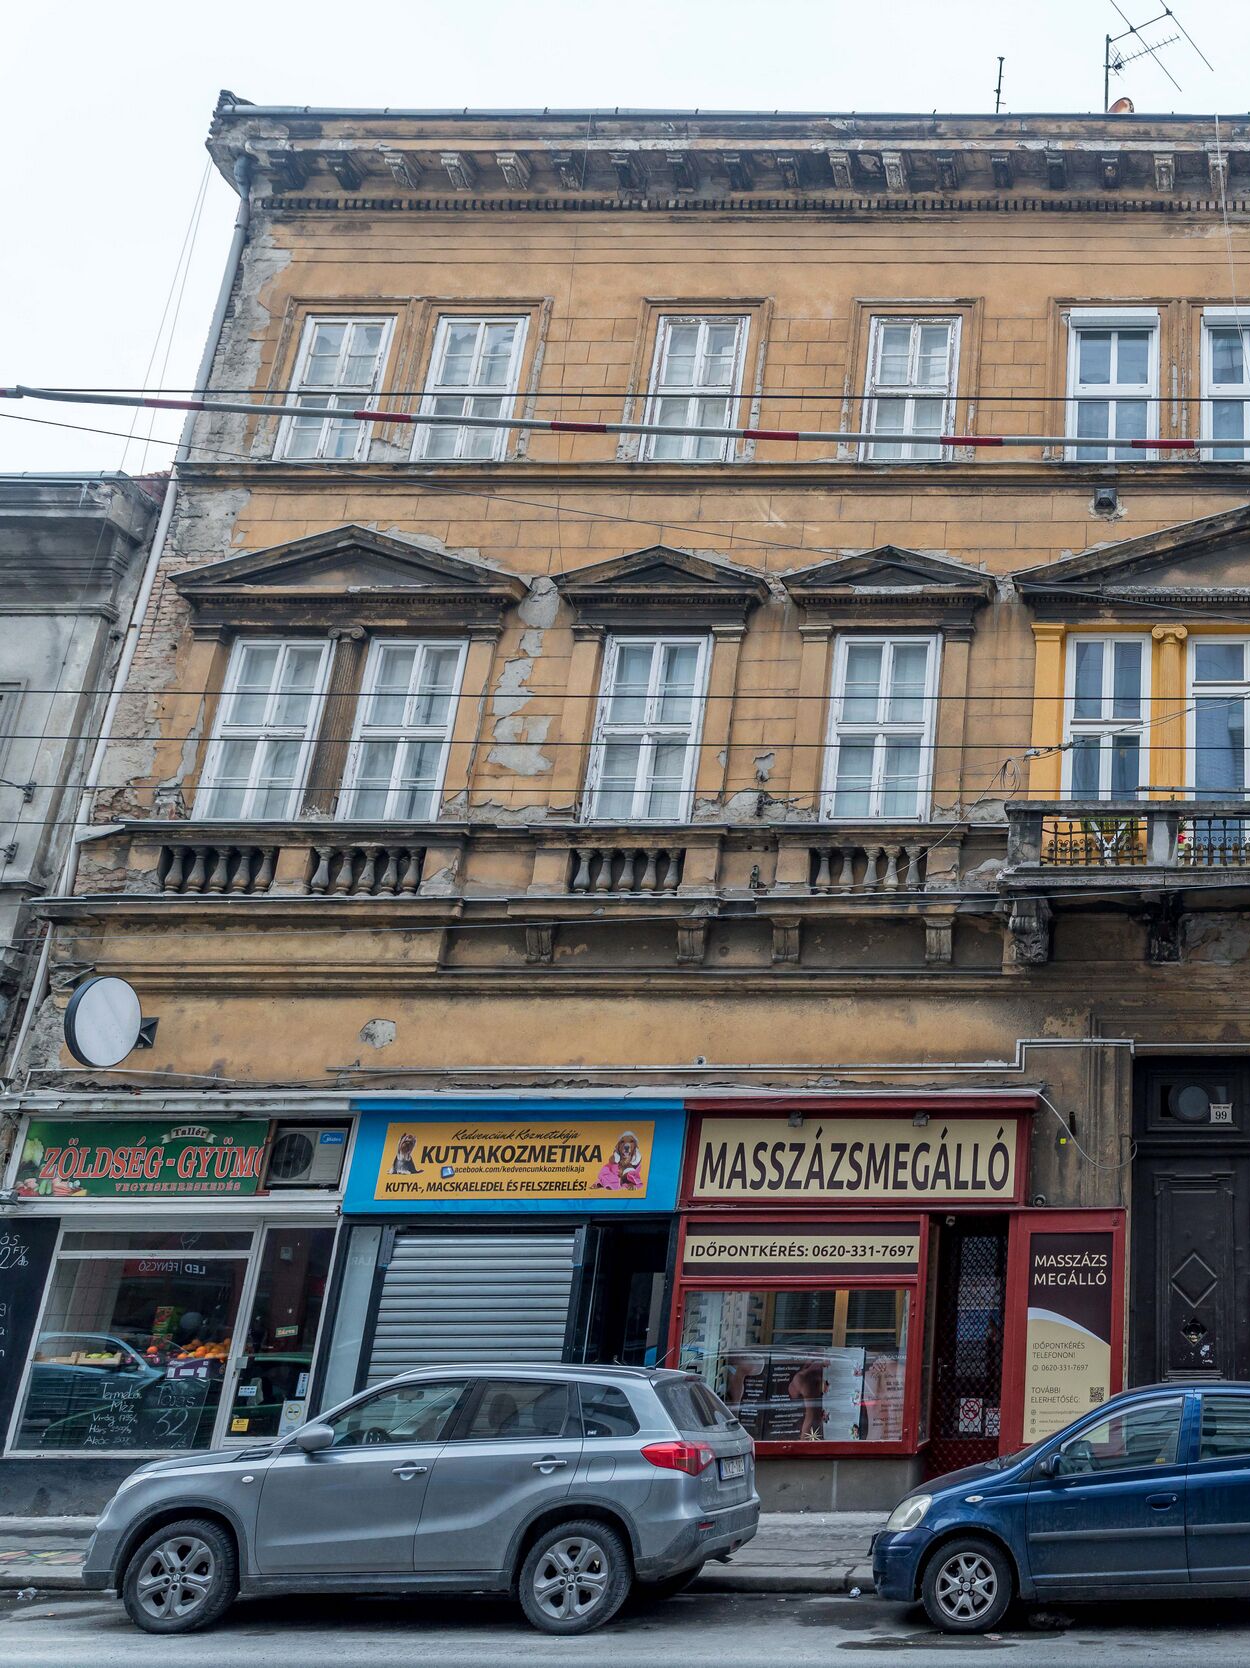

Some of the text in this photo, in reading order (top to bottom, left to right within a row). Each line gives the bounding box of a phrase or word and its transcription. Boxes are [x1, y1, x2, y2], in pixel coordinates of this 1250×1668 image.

[1215, 1111, 1227, 1120] 99
[451, 1128, 581, 1143] Kedvencünk Kozmetikája
[39, 1136, 264, 1179] ZÖLDSÉG-GYÜM
[421, 1144, 603, 1164] KUTYAKOZMETIKA
[699, 1126, 1010, 1191] MASSZÁZSMEGÁLLÓ
[115, 1181, 241, 1192] VEGYESKERESKEDÉS
[385, 1179, 588, 1193] KUTYA-, MACSKAELEDEL ÉS FELSZERELÉS!
[690, 1241, 915, 1257] IDŐPONTKÉRÉS: 0620-331-7697
[1034, 1251, 1108, 1267] MASSZÁZS
[1034, 1269, 1107, 1286] MEGÁLLÓ
[1032, 1341, 1086, 1350] IDŐPONTKÉRÉS
[1041, 1364, 1089, 1372] 0620-331-7697
[1031, 1386, 1061, 1394] TOVÁBBI
